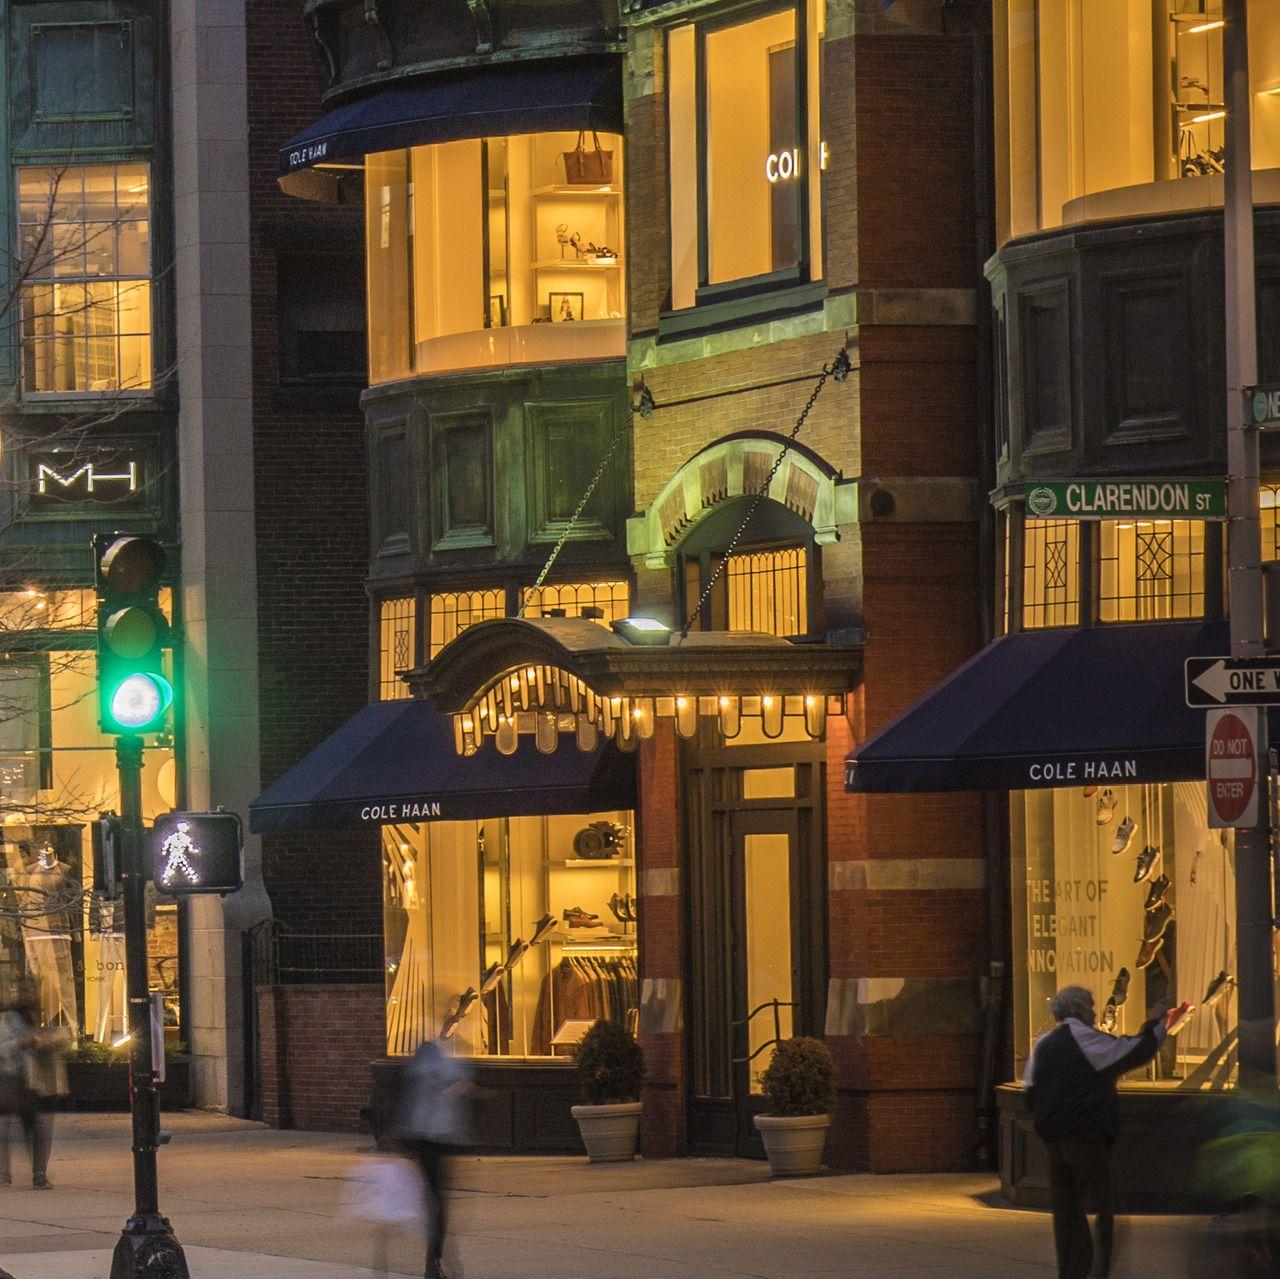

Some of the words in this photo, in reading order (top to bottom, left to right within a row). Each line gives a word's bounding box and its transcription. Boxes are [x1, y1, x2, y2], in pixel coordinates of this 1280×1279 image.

[1066, 483, 1190, 512] CLARENDON
[1196, 494, 1212, 510] ST
[1230, 671, 1265, 690] ONE
[1213, 740, 1225, 755] DO
[1227, 738, 1248, 754] NOT
[1030, 763, 1076, 781] COLE
[1084, 760, 1137, 778] HAAN
[1217, 782, 1244, 798] ENTER
[361, 805, 397, 820] COLE
[402, 802, 441, 817] HAAN
[1056, 881, 1081, 902] ART
[1086, 880, 1108, 902] OF
[1033, 914, 1097, 937] ELEGANT
[1028, 950, 1114, 973] NNOVATION
